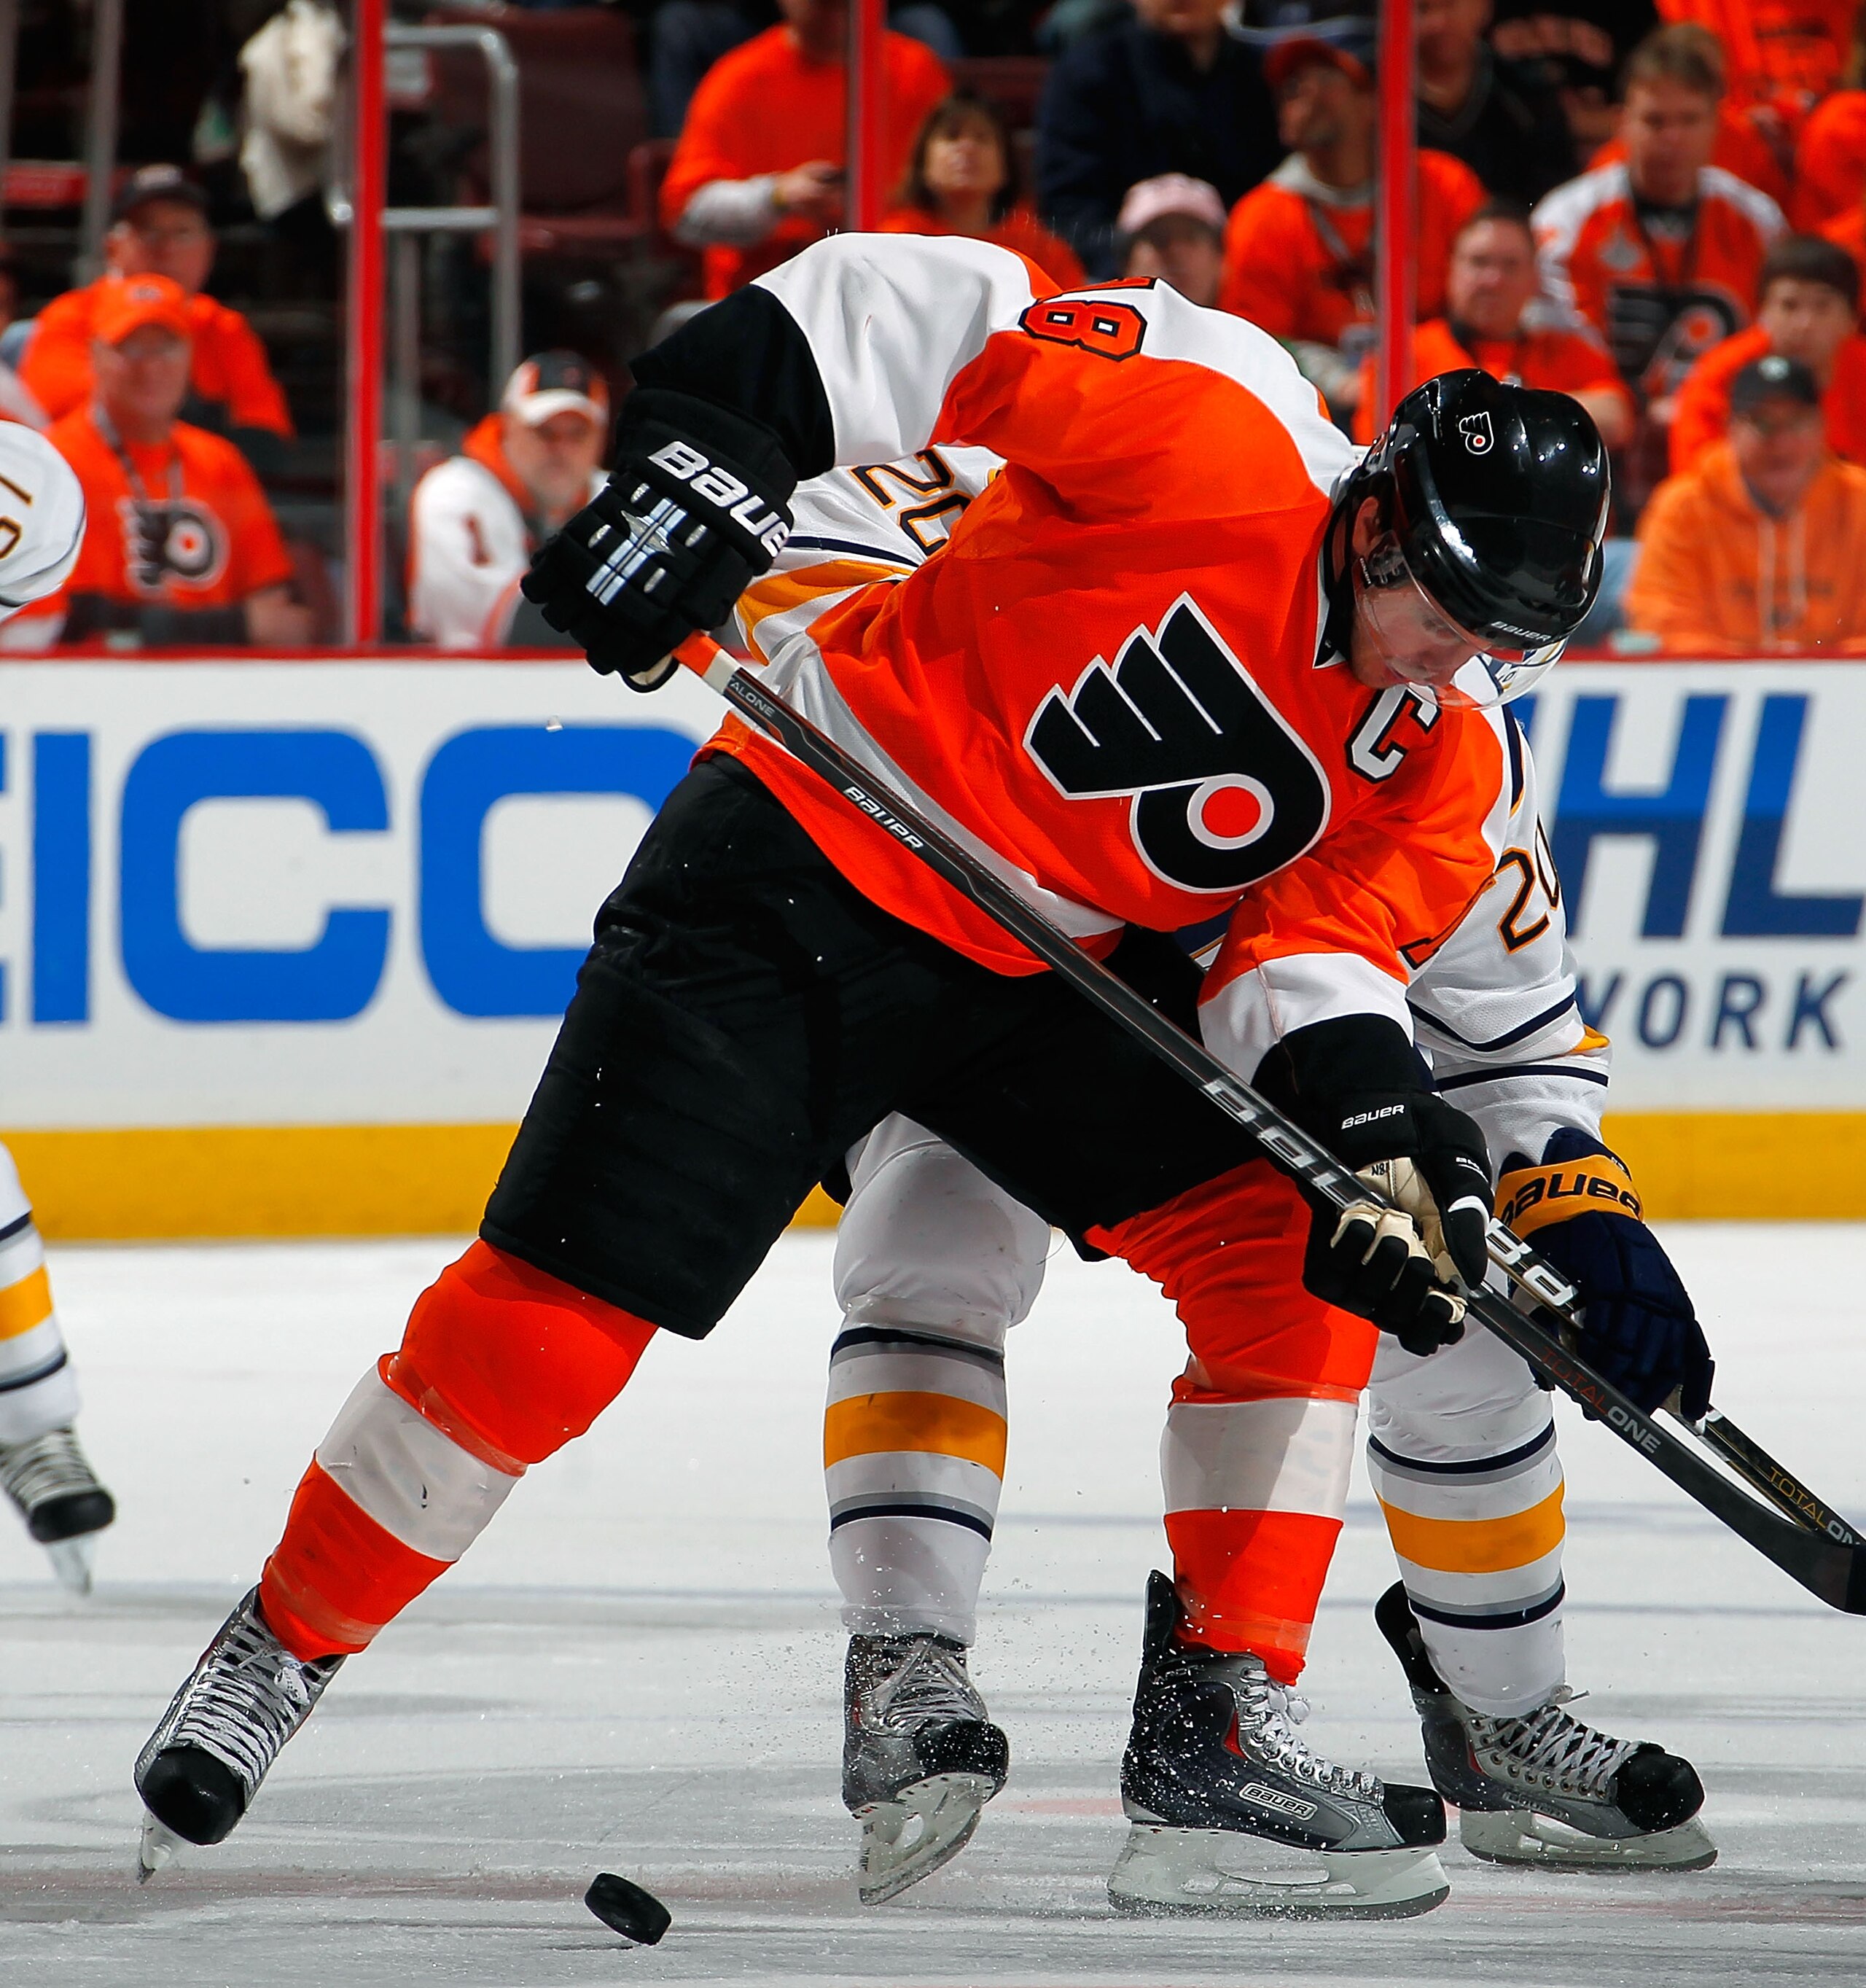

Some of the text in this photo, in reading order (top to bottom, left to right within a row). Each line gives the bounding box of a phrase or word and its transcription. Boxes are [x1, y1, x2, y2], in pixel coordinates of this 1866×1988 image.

[647, 440, 791, 558] BAUE
[1491, 620, 1552, 642] BAUER
[1344, 684, 1442, 784] C
[0, 720, 704, 1026] ICO
[1341, 1104, 1405, 1130] BAUER
[1246, 1788, 1310, 1814] BAUER
